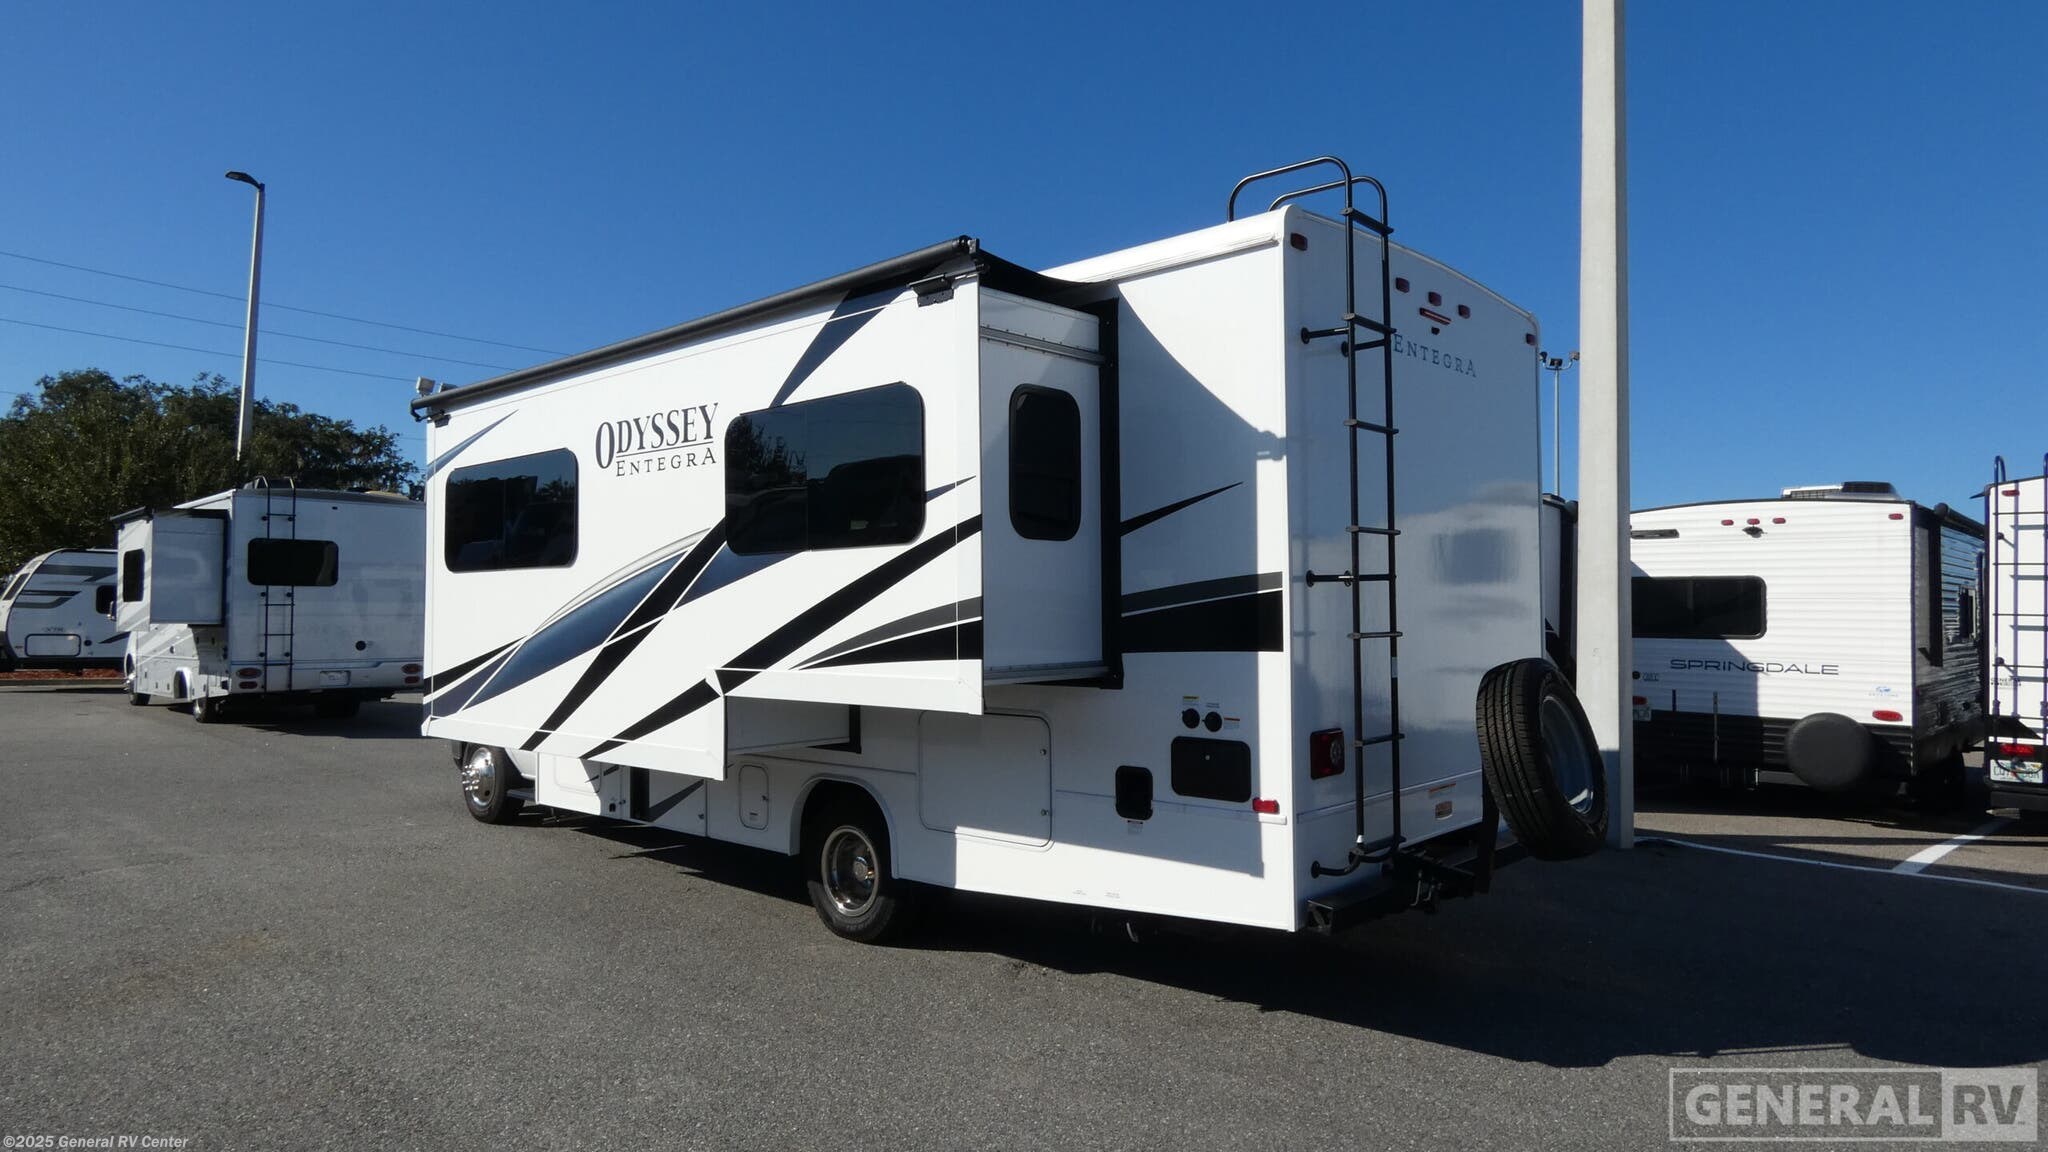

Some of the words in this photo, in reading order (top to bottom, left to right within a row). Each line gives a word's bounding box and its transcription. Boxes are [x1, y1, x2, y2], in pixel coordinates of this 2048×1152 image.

[1394, 333, 1476, 378] ENTEGRA
[595, 402, 719, 469] ODYSSEY
[616, 447, 716, 477] ENTEGRA
[1670, 659, 1839, 675] SPRINGDALE
